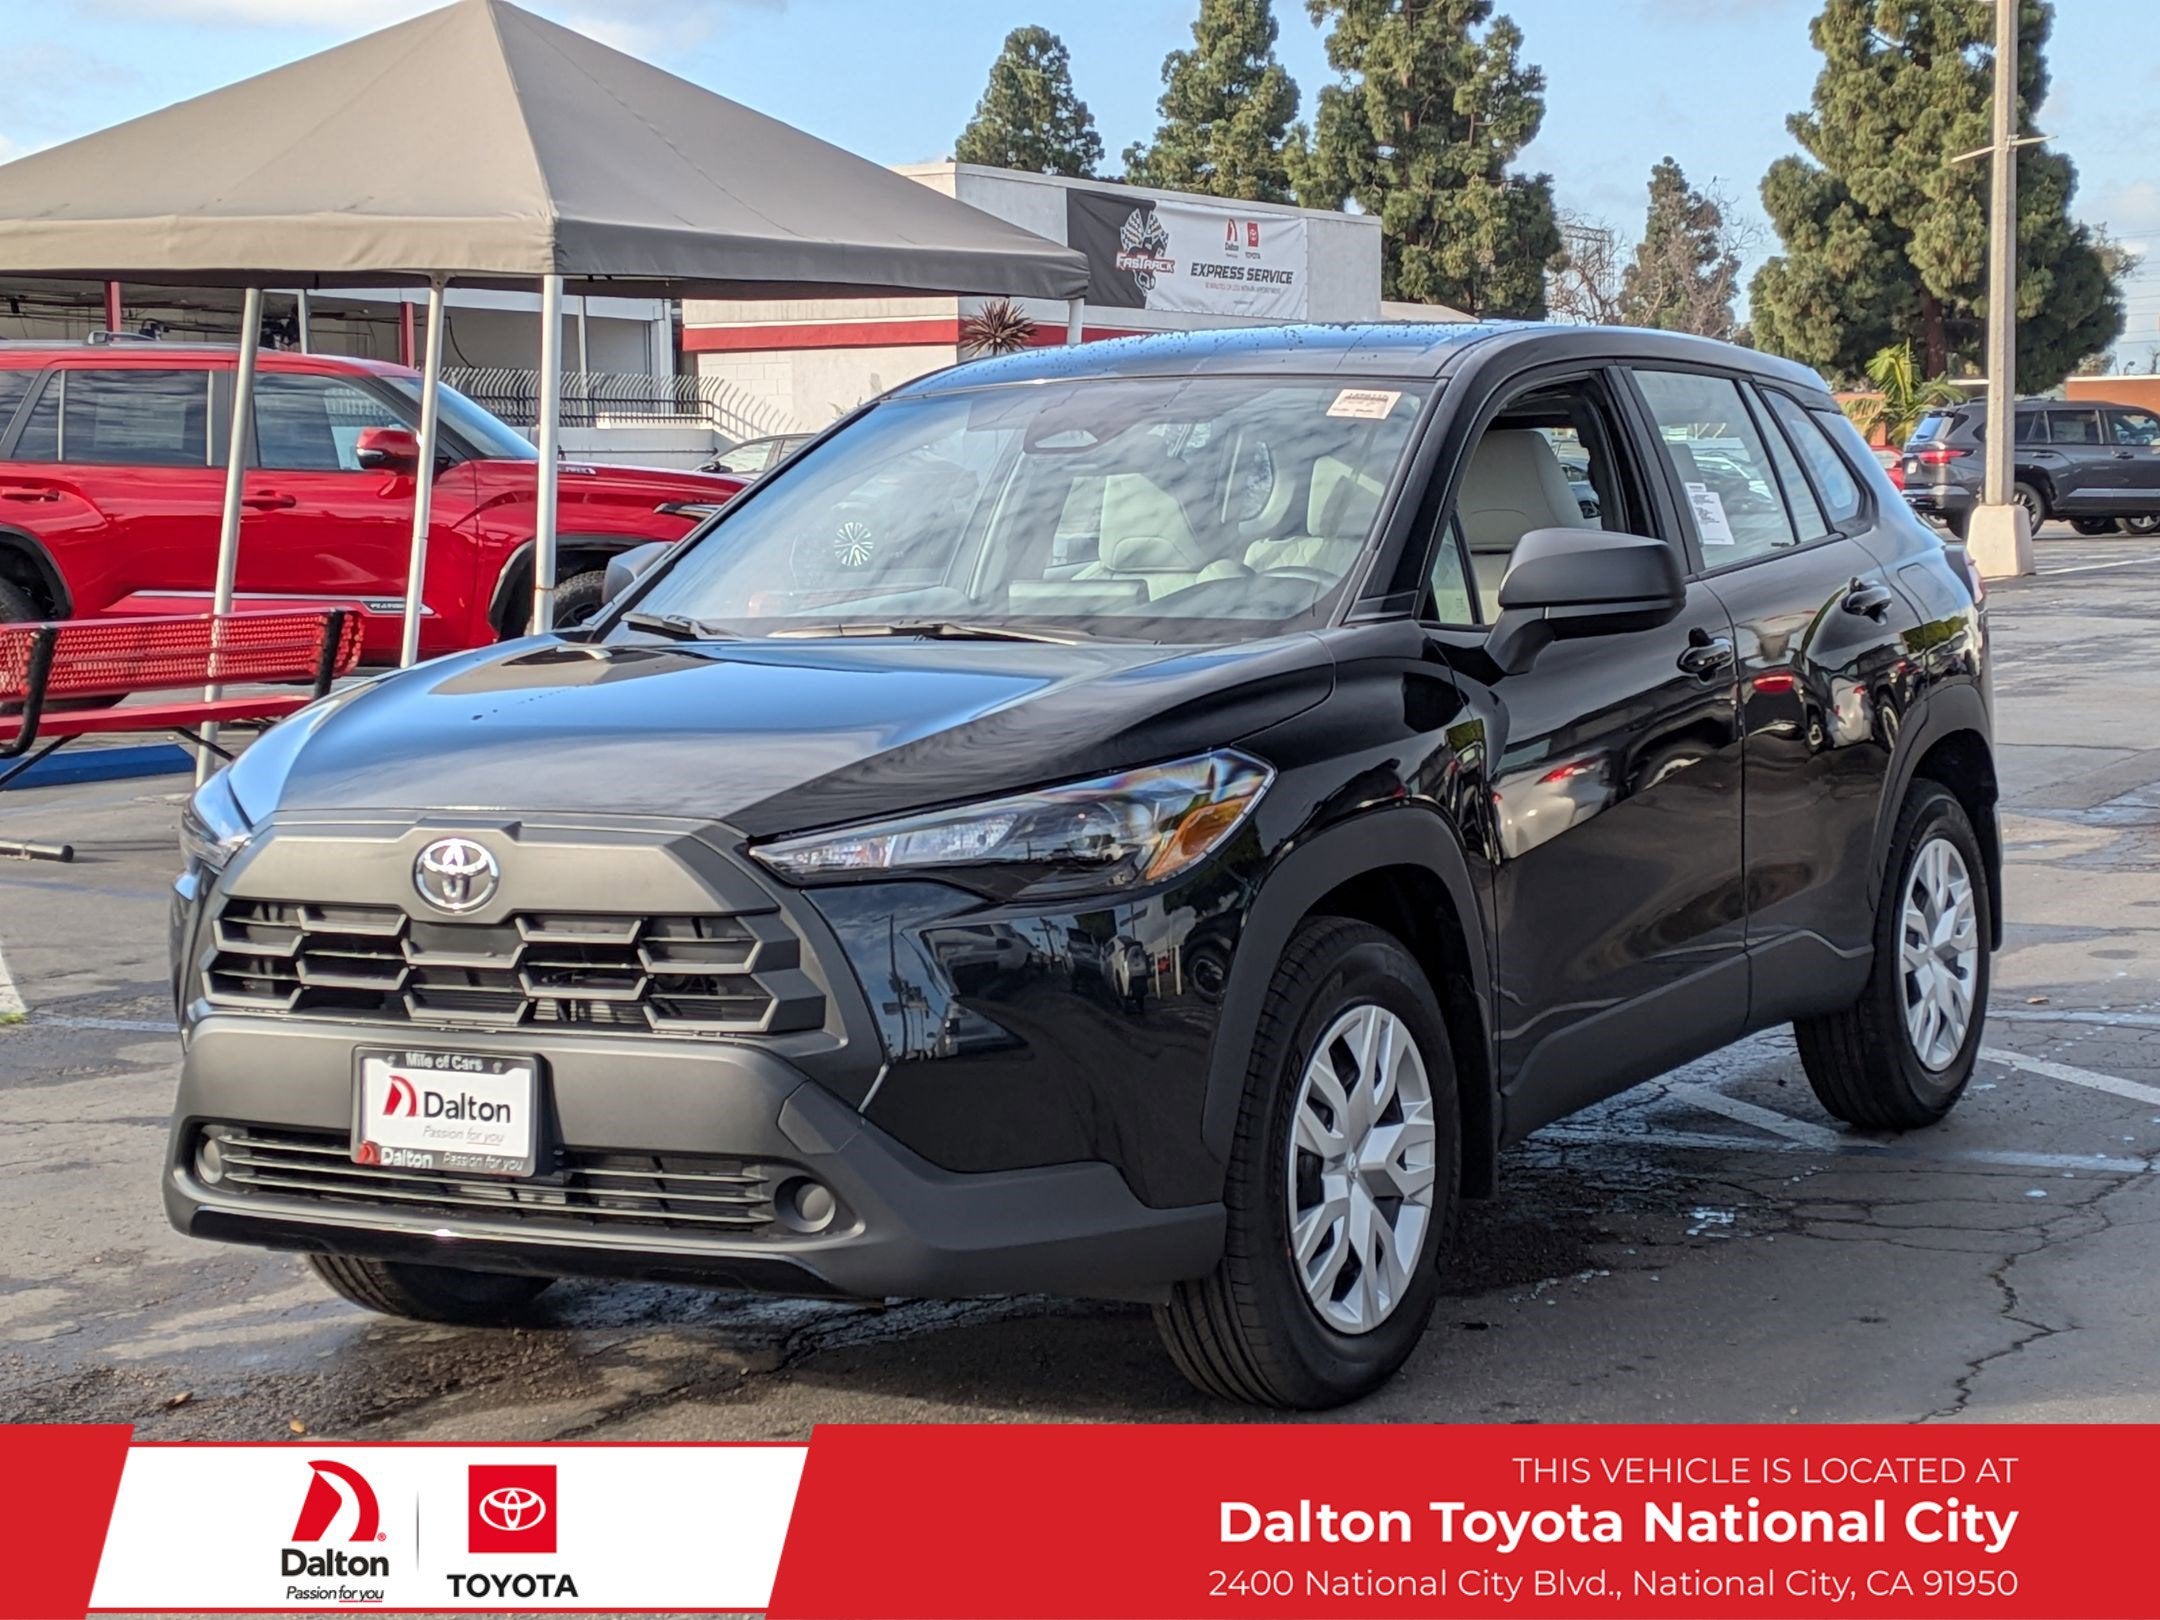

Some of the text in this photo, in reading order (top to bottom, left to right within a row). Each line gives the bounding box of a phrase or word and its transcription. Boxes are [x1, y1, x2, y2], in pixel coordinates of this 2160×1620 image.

[1190, 262, 1294, 285] EXPRESS SERVICE
[405, 1052, 483, 1071] Mile of Cars
[423, 1091, 511, 1124] Dalton
[423, 1125, 505, 1144] Passion for you
[380, 1147, 524, 1172] Dalton Passion for you
